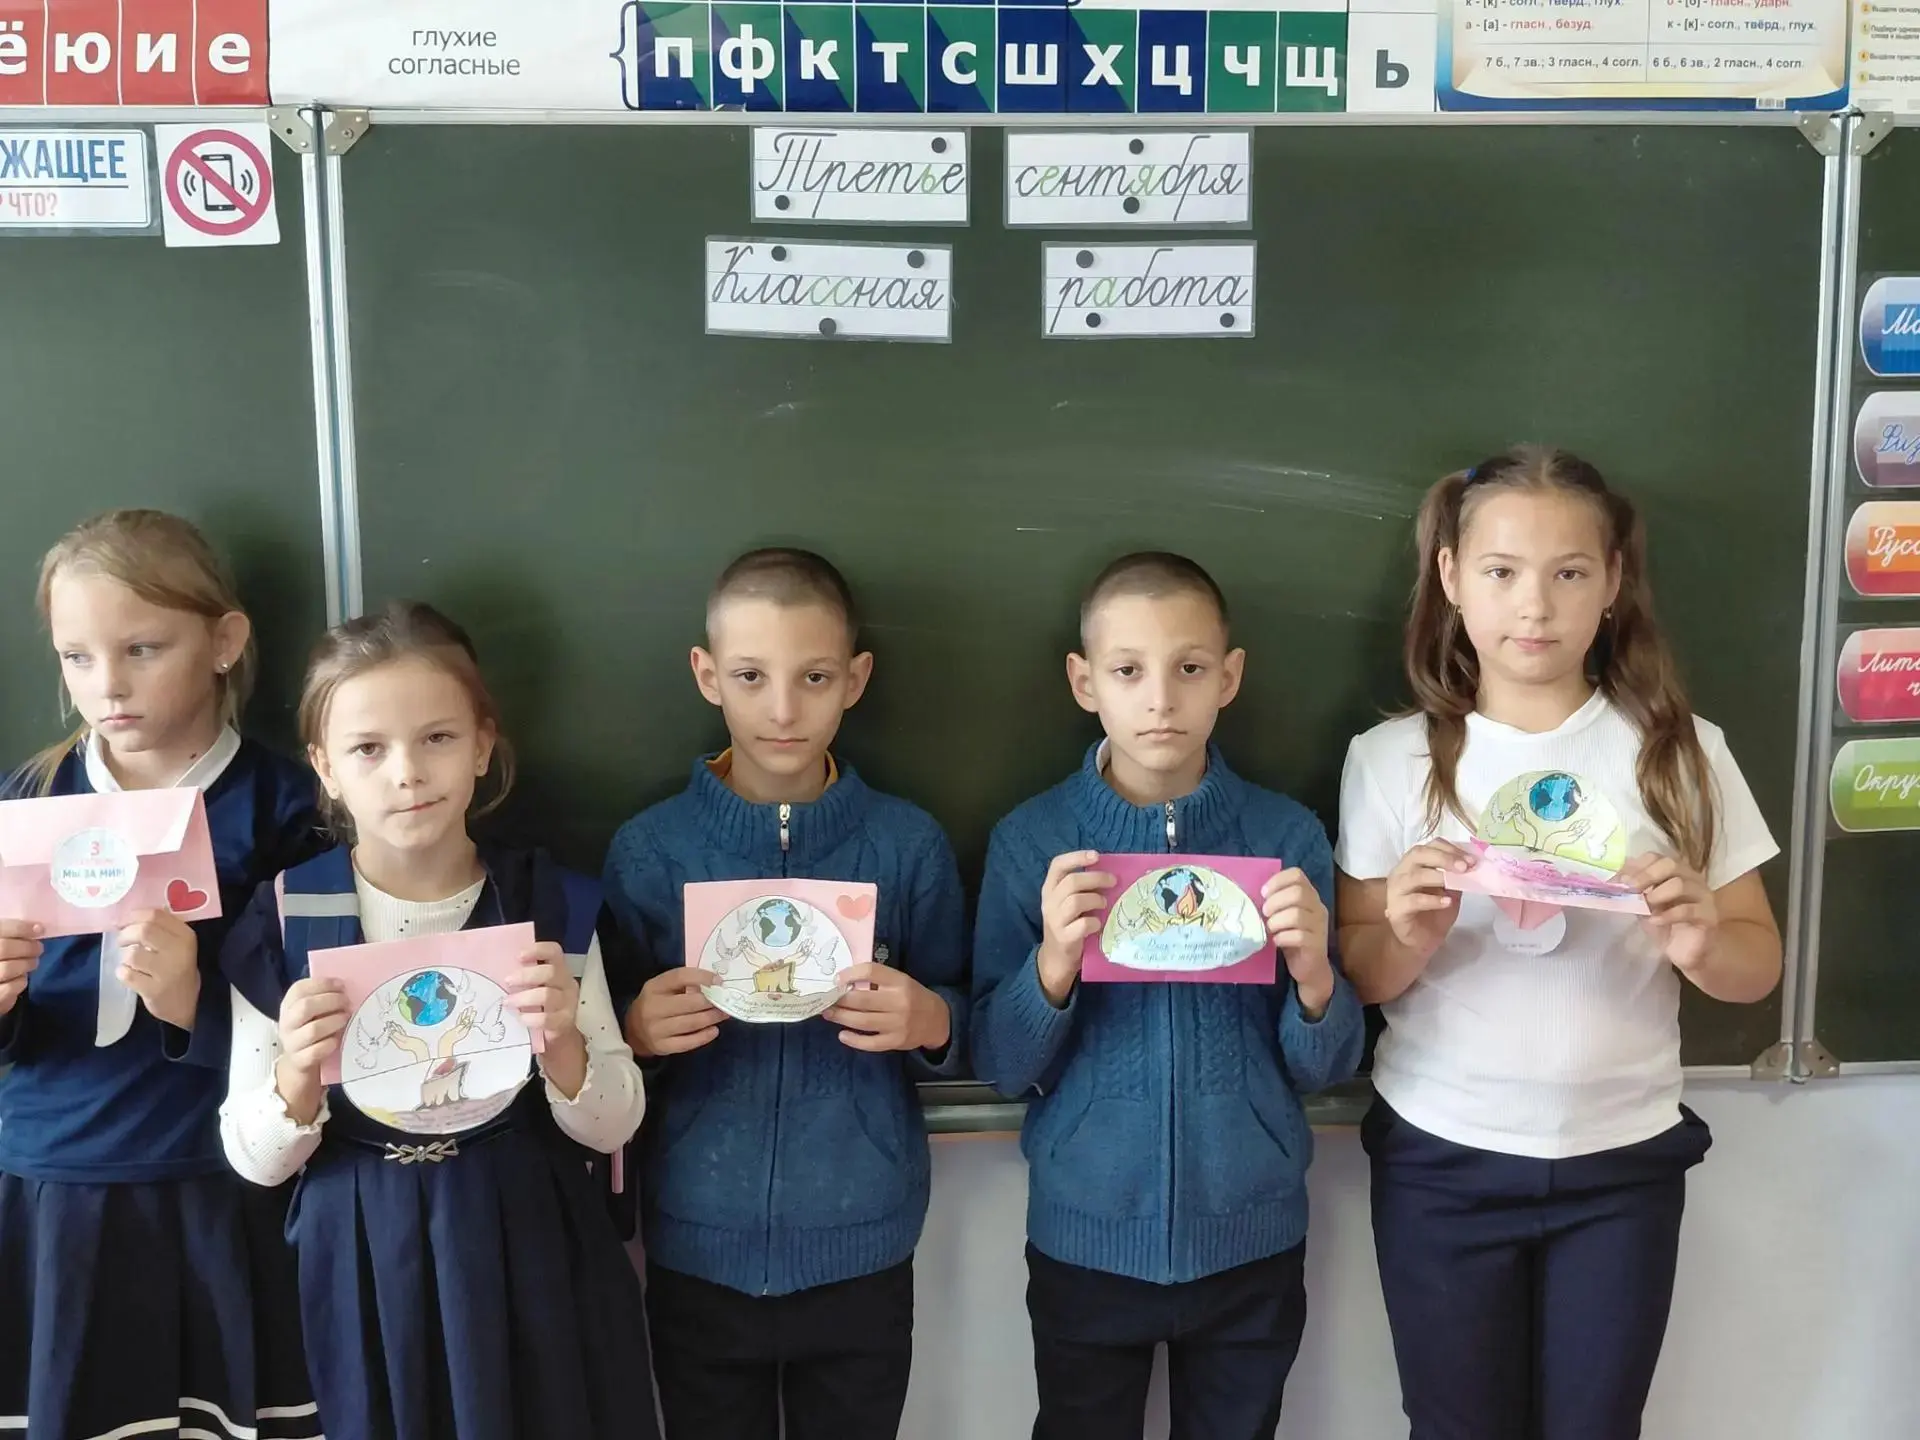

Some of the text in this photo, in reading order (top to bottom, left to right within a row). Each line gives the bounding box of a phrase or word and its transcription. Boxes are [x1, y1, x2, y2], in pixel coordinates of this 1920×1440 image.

[1465, 21, 1472, 29] а
[1483, 19, 1499, 31] [а]
[1667, 20, 1673, 28] к
[1708, 20, 1740, 30] согл.,
[1744, 19, 1785, 31] твёрд.,
[1789, 20, 1817, 32] глух.
[0, 20, 251, 75] ё ю и е
[413, 30, 497, 52] глухие
[388, 58, 520, 76] согласные
[654, 23, 1410, 97] п ф к т с ш х ц ч щ ь
[1485, 57, 1493, 67] 7
[1496, 57, 1510, 69] б.,
[1514, 57, 1520, 67] 7
[1548, 57, 1555, 67] 3
[1558, 58, 1599, 69] гласн.,
[1602, 57, 1609, 67] 4
[1612, 59, 1642, 68] согл.
[1653, 58, 1659, 68] 6
[1663, 57, 1677, 69] б.,
[1680, 58, 1687, 68] 6
[1714, 58, 1721, 68] 2
[1724, 59, 1763, 69] гласн.,
[1766, 58, 1772, 68] 4
[0, 139, 128, 183] ЖАЩЕЕ
[758, 131, 1244, 222] Третье сентября
[711, 244, 1248, 335] Классная работа
